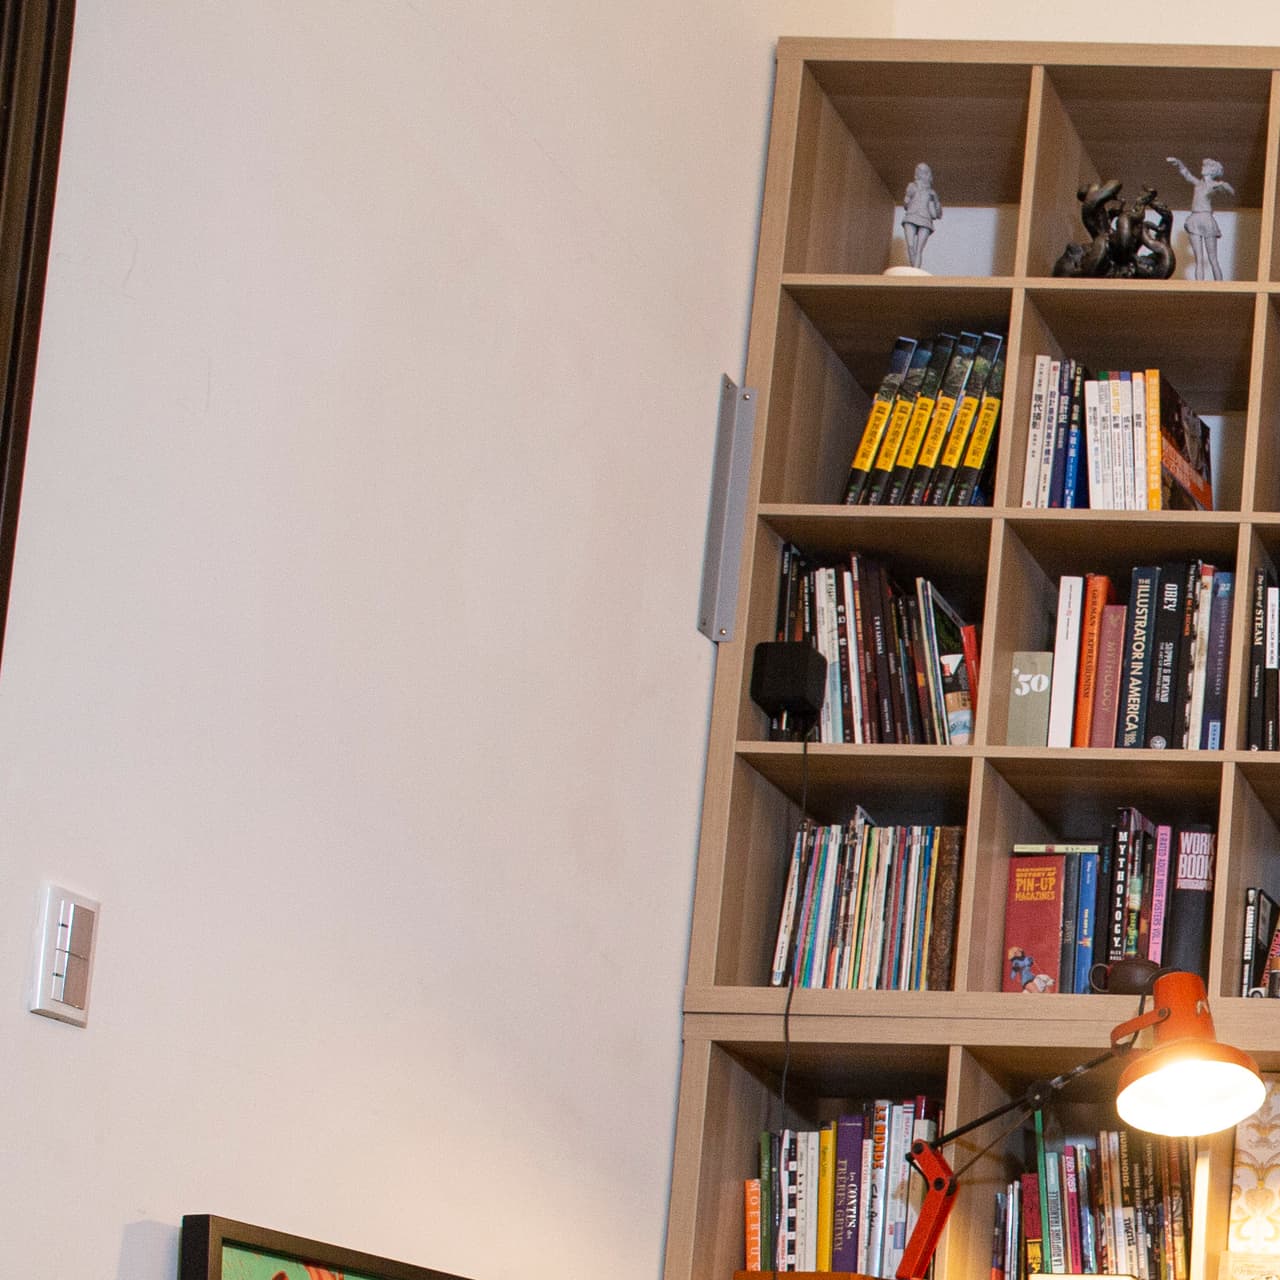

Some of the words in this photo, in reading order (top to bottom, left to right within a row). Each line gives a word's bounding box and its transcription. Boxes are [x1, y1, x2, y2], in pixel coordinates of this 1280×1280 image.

[1088, 589, 1098, 626] GERMAN
[1163, 583, 1178, 613] OBEY
[1134, 584, 1149, 660] ILLUSTRATOR
[1254, 608, 1265, 645] STEAM
[1083, 631, 1095, 699] EXPRESSIONISM
[1132, 661, 1145, 675] IN
[1164, 642, 1174, 666] SUPPLY
[1102, 641, 1116, 713] MYTHOLOGY
[1160, 675, 1171, 703] DEMAND
[1126, 676, 1143, 731] AMERICA
[1180, 832, 1214, 849] WORK
[1016, 877, 1056, 892] PIN-UP
[1179, 854, 1214, 880] BOOK
[1015, 892, 1056, 901] MAGAZINES
[1113, 831, 1128, 948] MYTHOLOGY
[1154, 898, 1164, 925] POSTERS
[877, 1104, 887, 1122] LE
[873, 1123, 886, 1170] MONDE
[1118, 1130, 1127, 1188] HUMANOIDS
[835, 1158, 848, 1206] FRÈRES
[844, 1182, 859, 1227] CONTES
[1050, 1190, 1061, 1228] TRANQUILLE
[750, 1181, 761, 1272] MOEBIUS
[832, 1209, 845, 1252] GRIMM
[1051, 1229, 1062, 1258] RUPTURE
